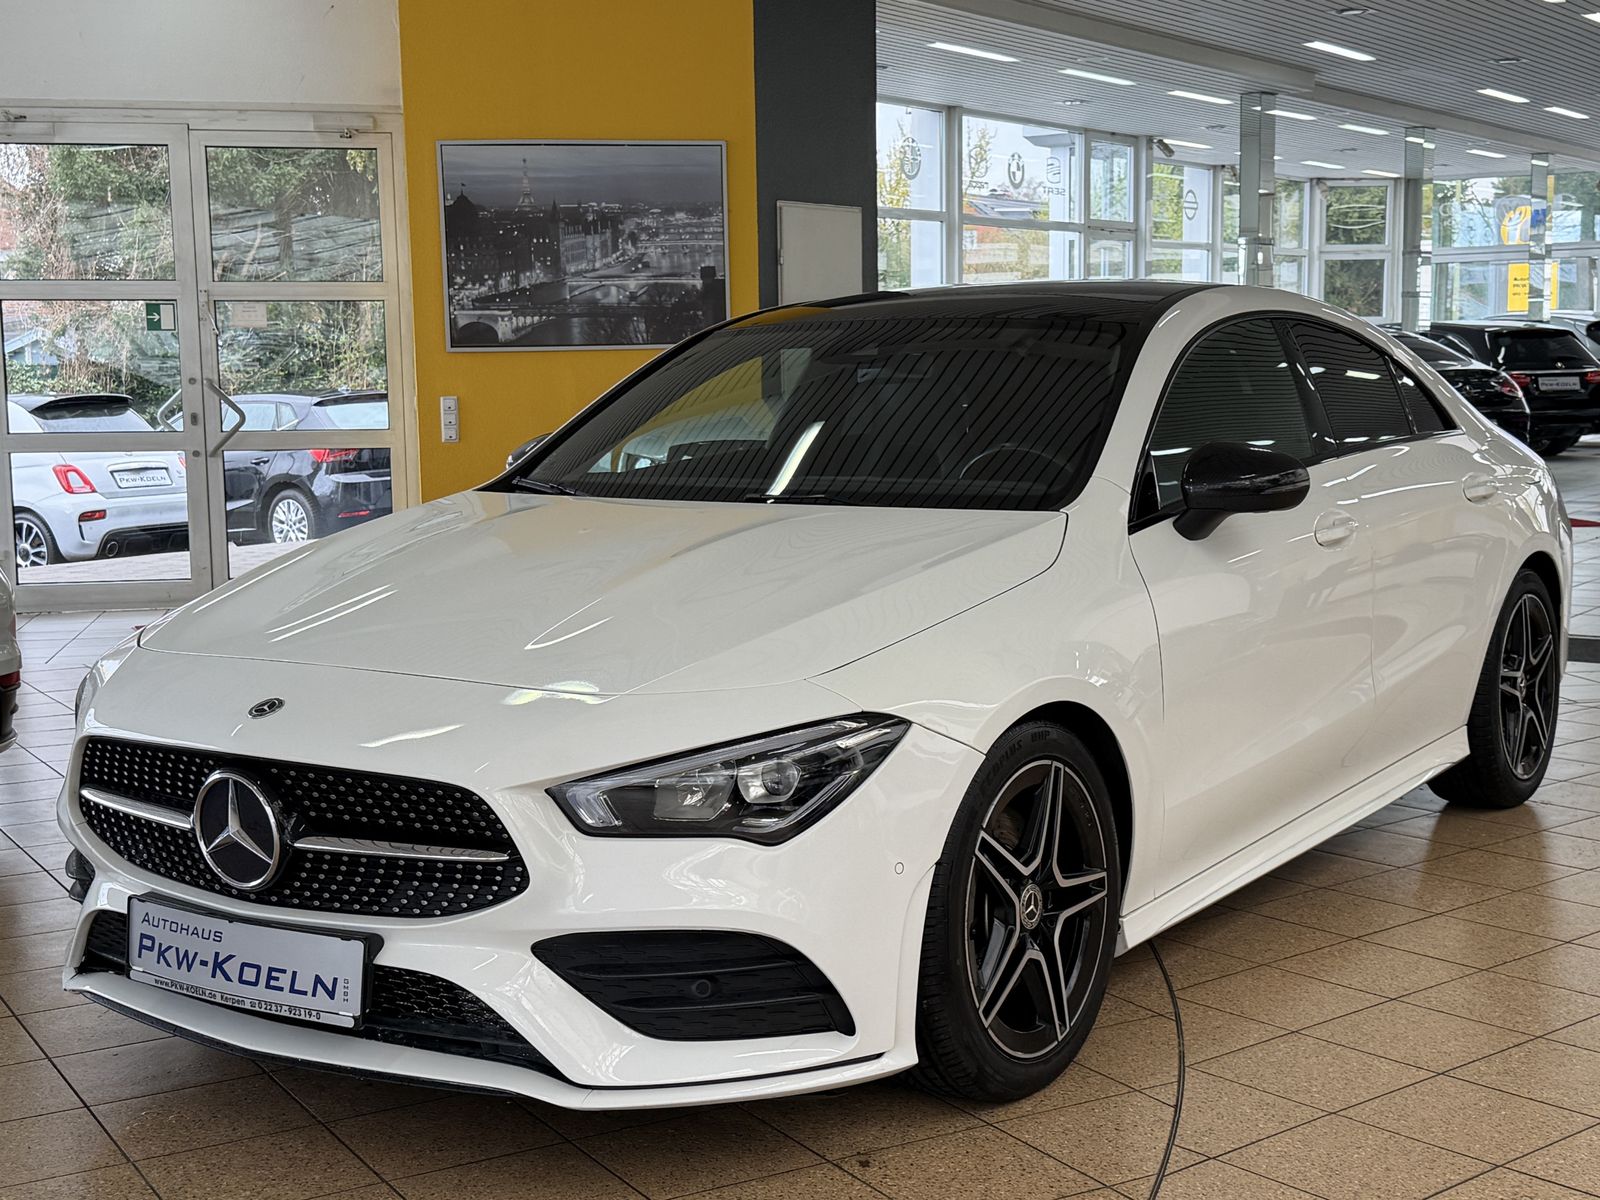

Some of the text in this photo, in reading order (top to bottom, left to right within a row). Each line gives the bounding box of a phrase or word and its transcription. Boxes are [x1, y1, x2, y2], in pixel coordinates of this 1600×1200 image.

[141, 911, 223, 943] AUTOHAUS
[137, 932, 339, 1001] PKW-KOELN
[220, 993, 246, 1007] Kerpen
